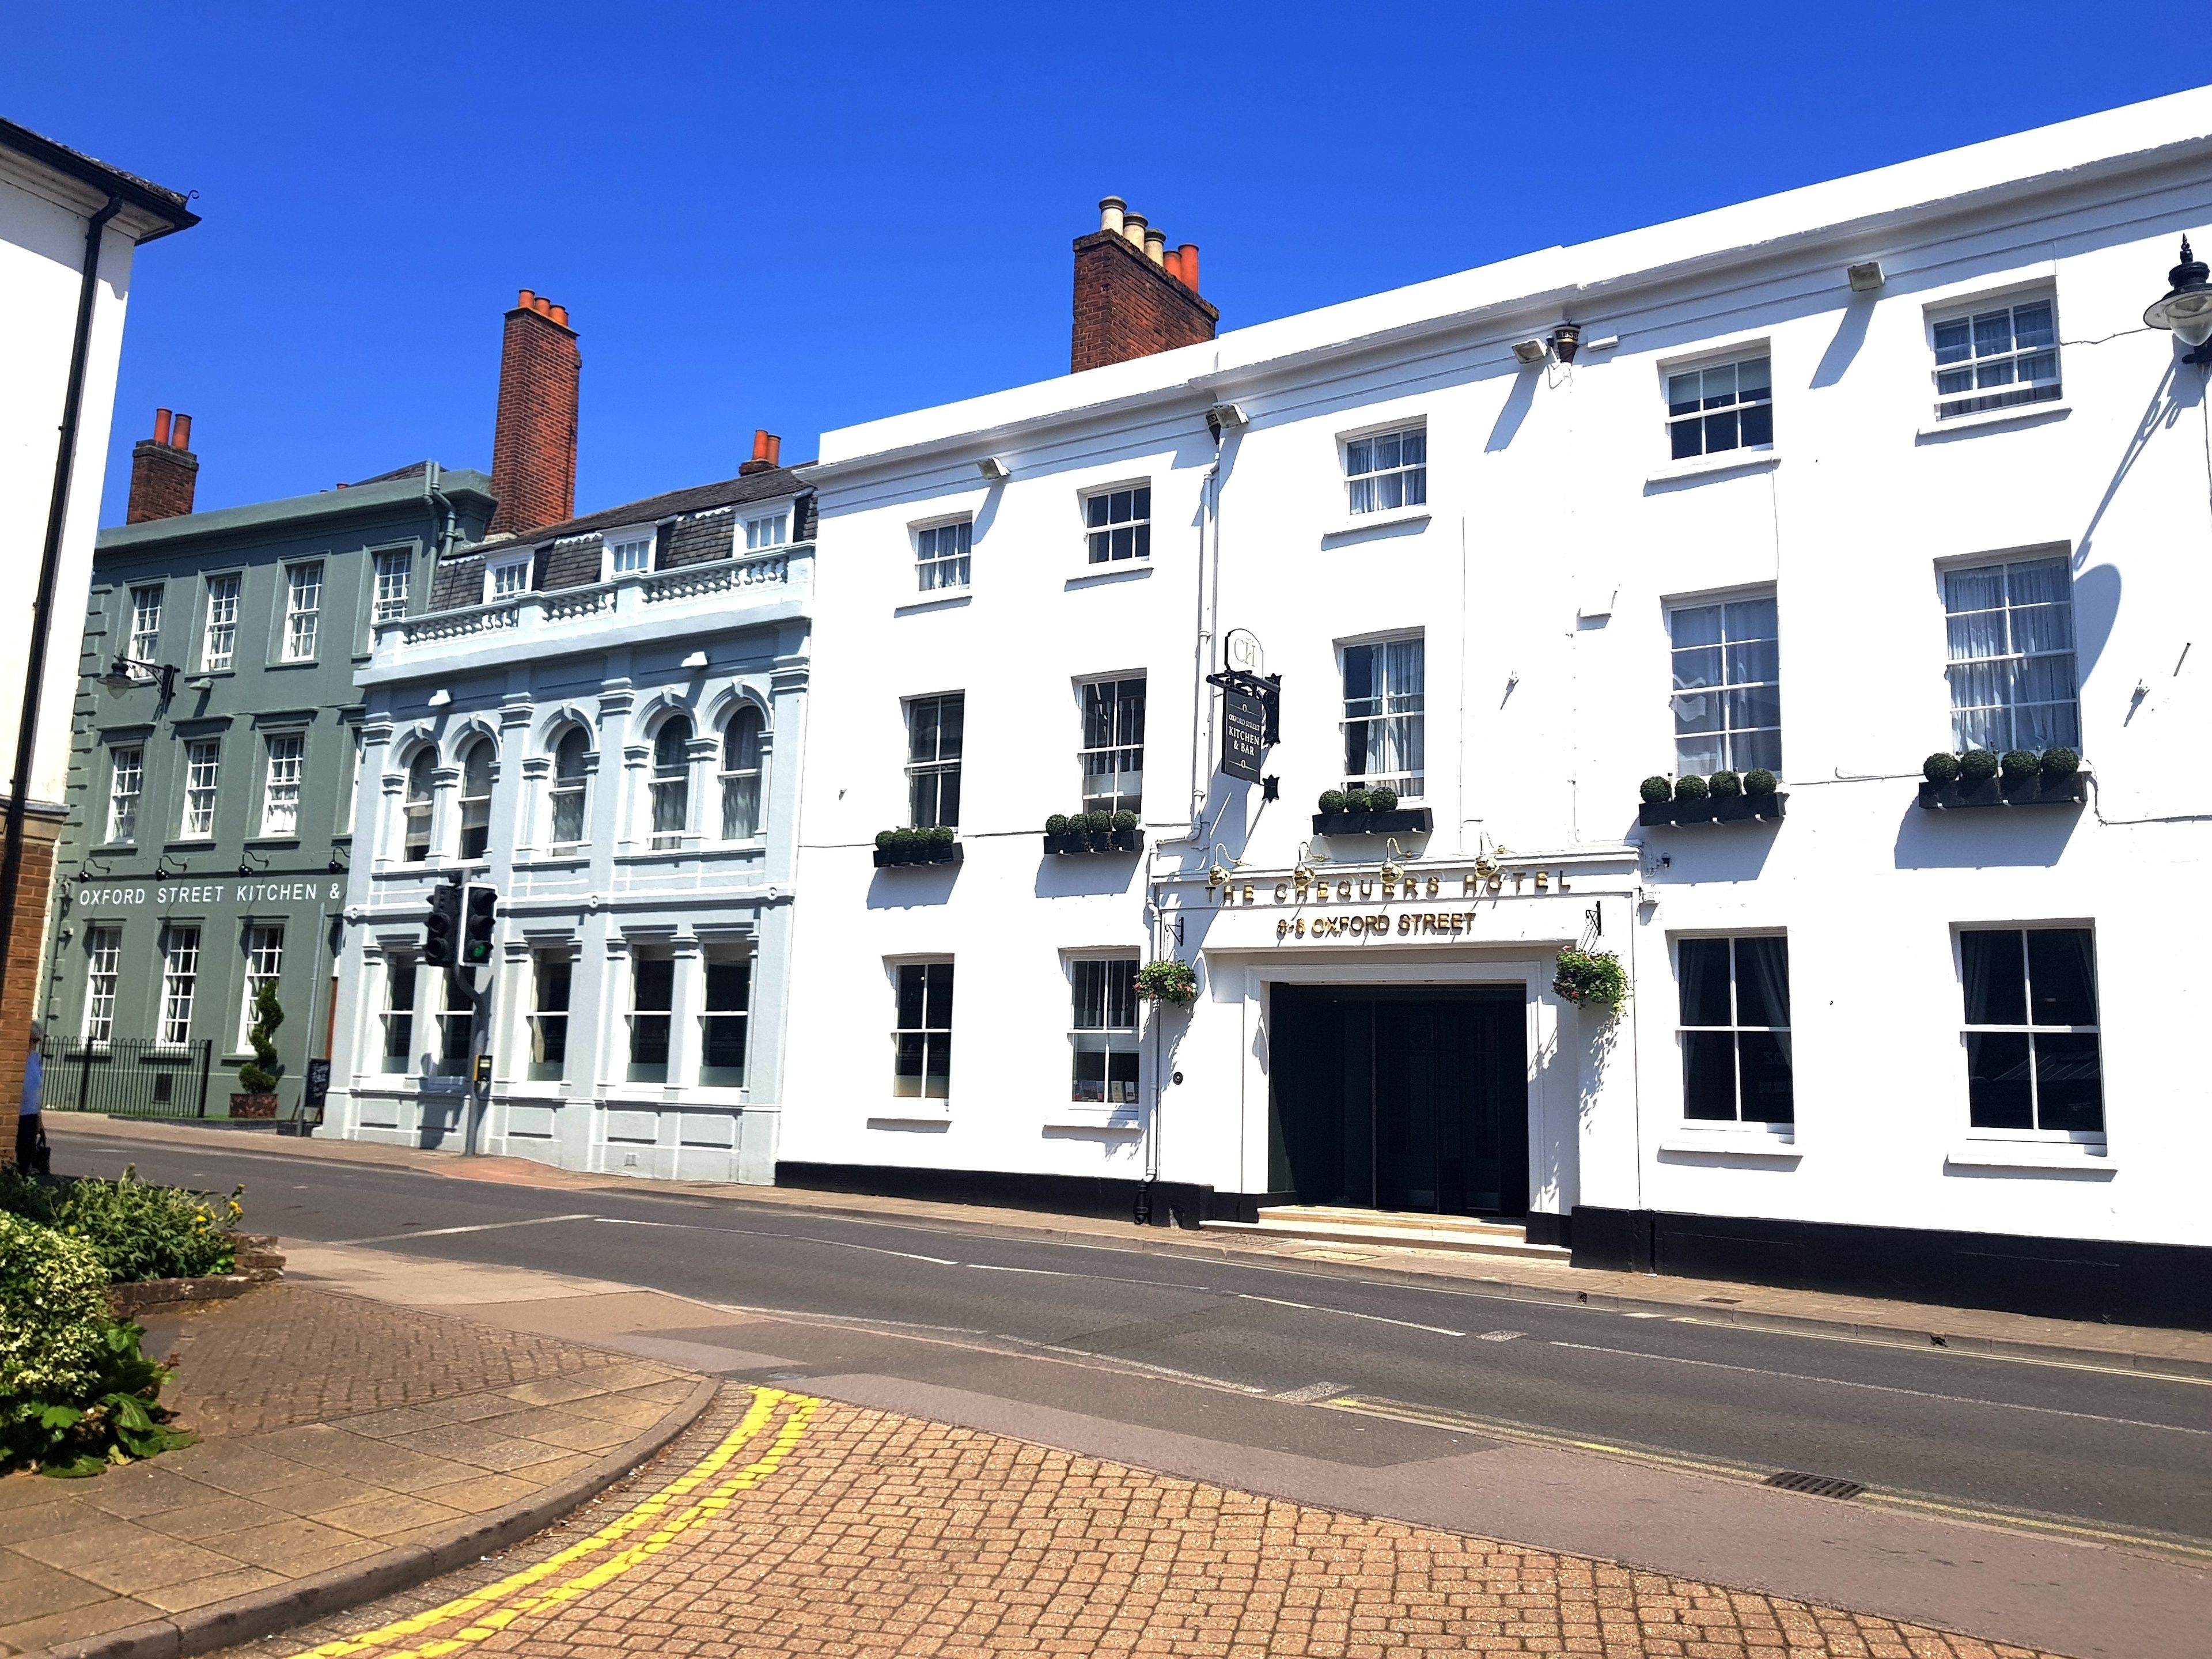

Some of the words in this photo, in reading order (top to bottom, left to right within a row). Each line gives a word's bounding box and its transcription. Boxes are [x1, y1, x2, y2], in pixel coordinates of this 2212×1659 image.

[1234, 638, 1256, 667] CH
[1229, 713, 1245, 726] OXFORD
[1245, 720, 1260, 732] STREET
[1229, 726, 1260, 746] KITCHEN
[1233, 740, 1240, 750] &
[1241, 743, 1255, 756] BAR
[79, 888, 146, 906] OXFORD
[157, 885, 225, 903] STREET
[237, 883, 317, 902] KITCHEN
[329, 882, 340, 900] &
[1205, 884, 1255, 903] THE
[1275, 876, 1440, 900] CHEQUERS
[1464, 870, 1571, 892] HOTEL
[1313, 914, 1391, 934] OXFORD
[1398, 912, 1477, 931] STREET
